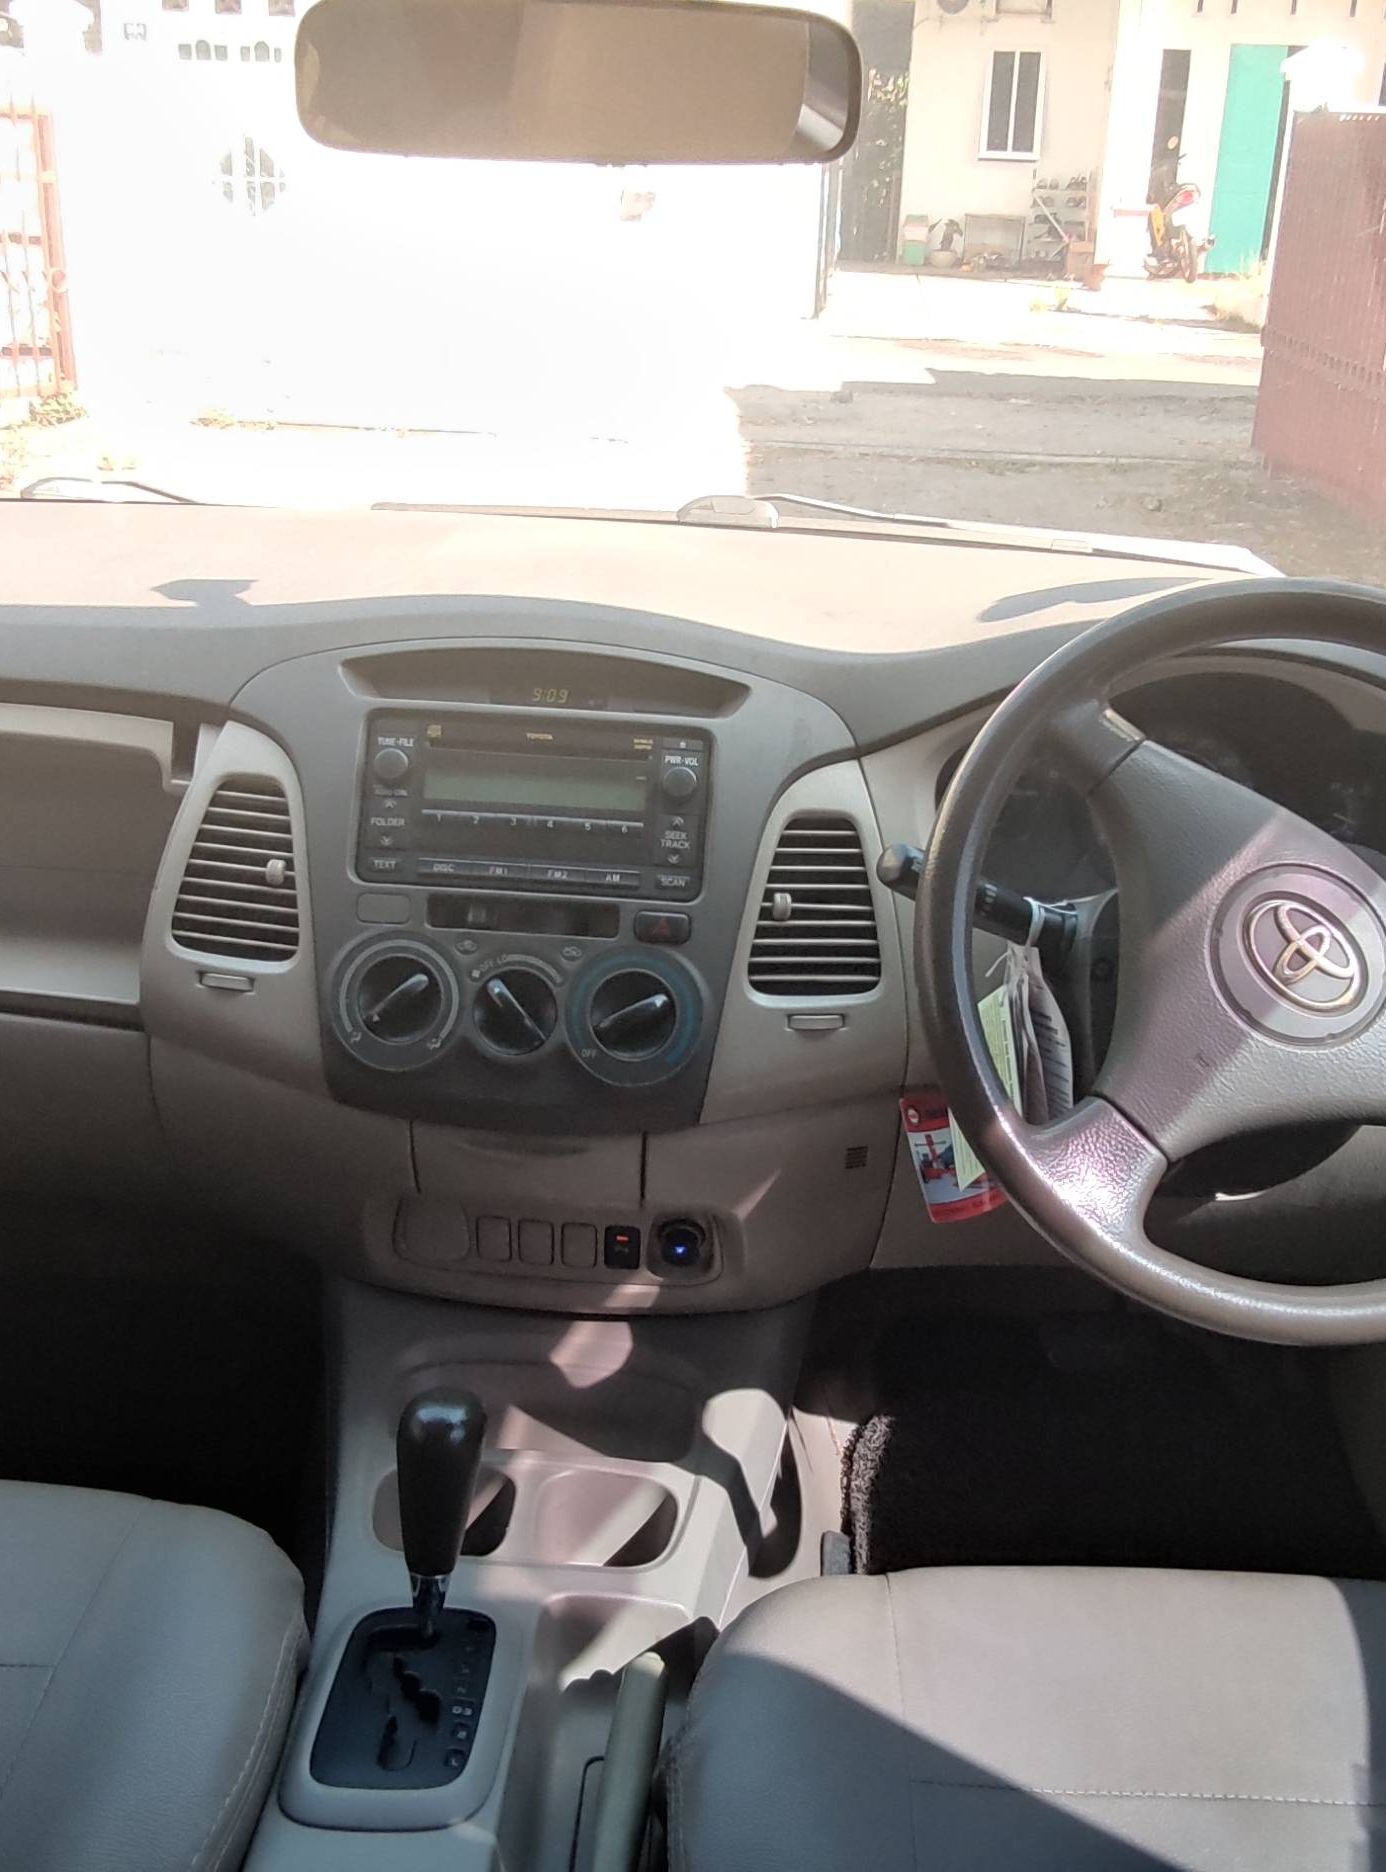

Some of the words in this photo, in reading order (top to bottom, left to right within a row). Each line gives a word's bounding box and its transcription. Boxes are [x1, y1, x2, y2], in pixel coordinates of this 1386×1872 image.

[532, 687, 568, 703] 9:09
[370, 816, 406, 827] FOLDER
[473, 816, 480, 825] 2
[510, 817, 517, 826] 3
[546, 819, 554, 829] 4
[584, 822, 592, 832] 5
[621, 825, 628, 834] 6
[664, 831, 687, 841] SEEK
[661, 839, 691, 850] TRACK
[373, 859, 397, 870] TEXT
[432, 863, 456, 873] DISC
[488, 866, 509, 876] FM1
[547, 869, 569, 880] FM2
[605, 873, 621, 883] AM
[660, 876, 687, 888] SCAN
